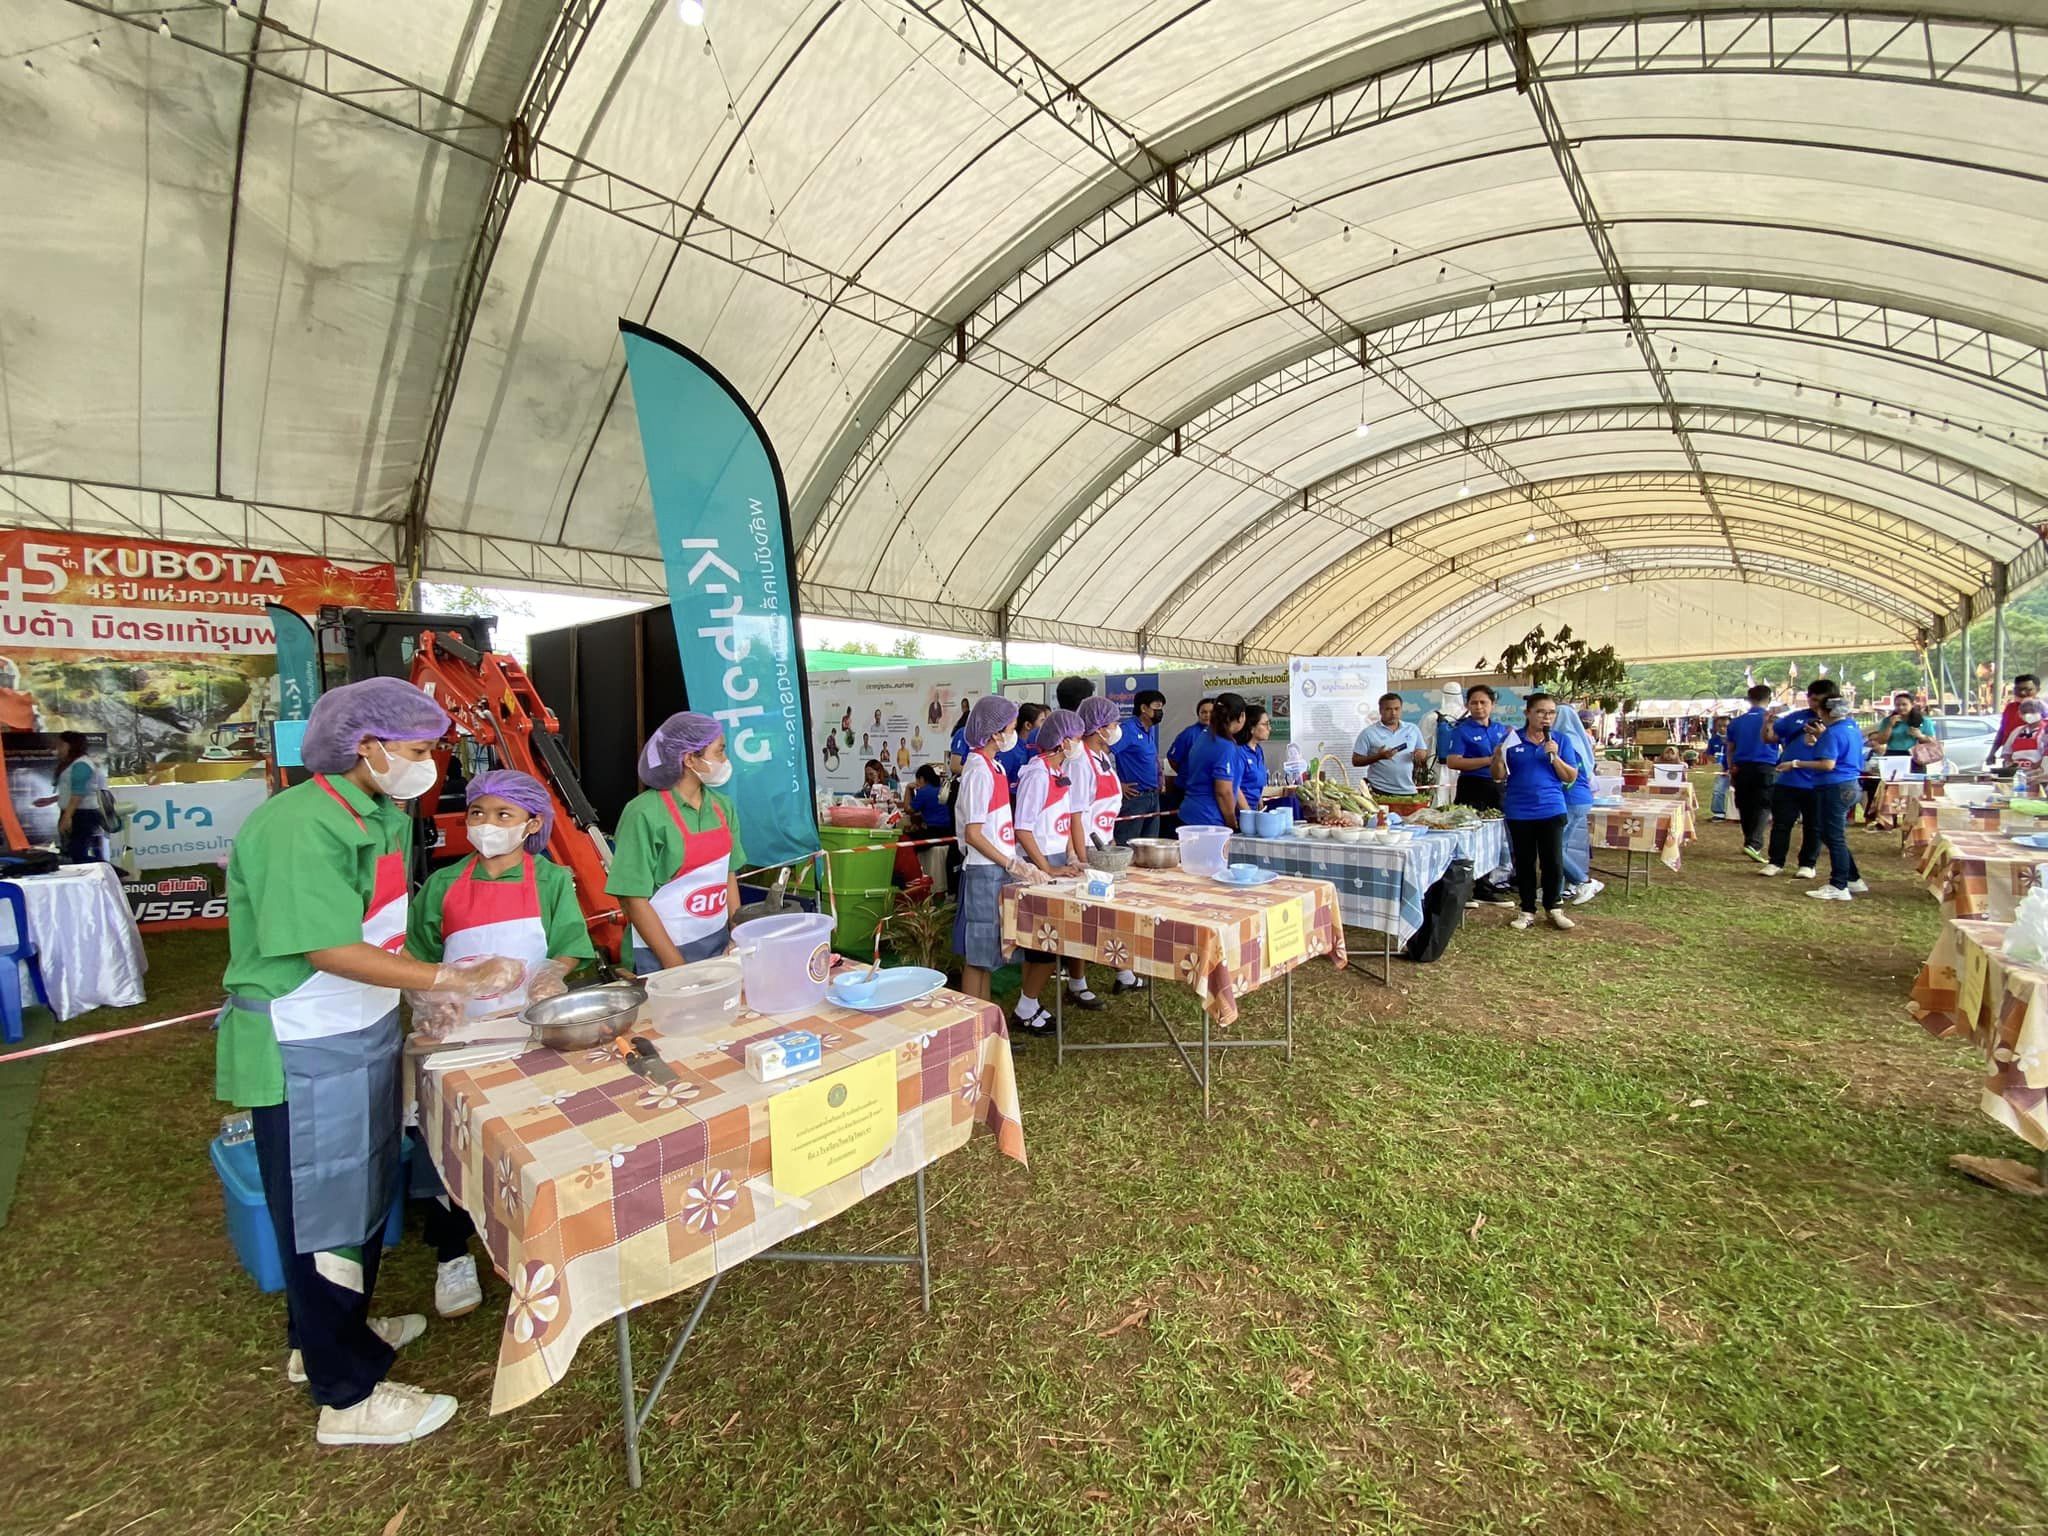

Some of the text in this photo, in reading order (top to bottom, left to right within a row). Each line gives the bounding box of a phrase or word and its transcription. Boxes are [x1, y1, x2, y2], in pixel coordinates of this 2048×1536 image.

[83, 547, 287, 586] KUBOTA
[86, 583, 117, 601] 45
[121, 582, 138, 601] ปี
[690, 888, 728, 913] aro
